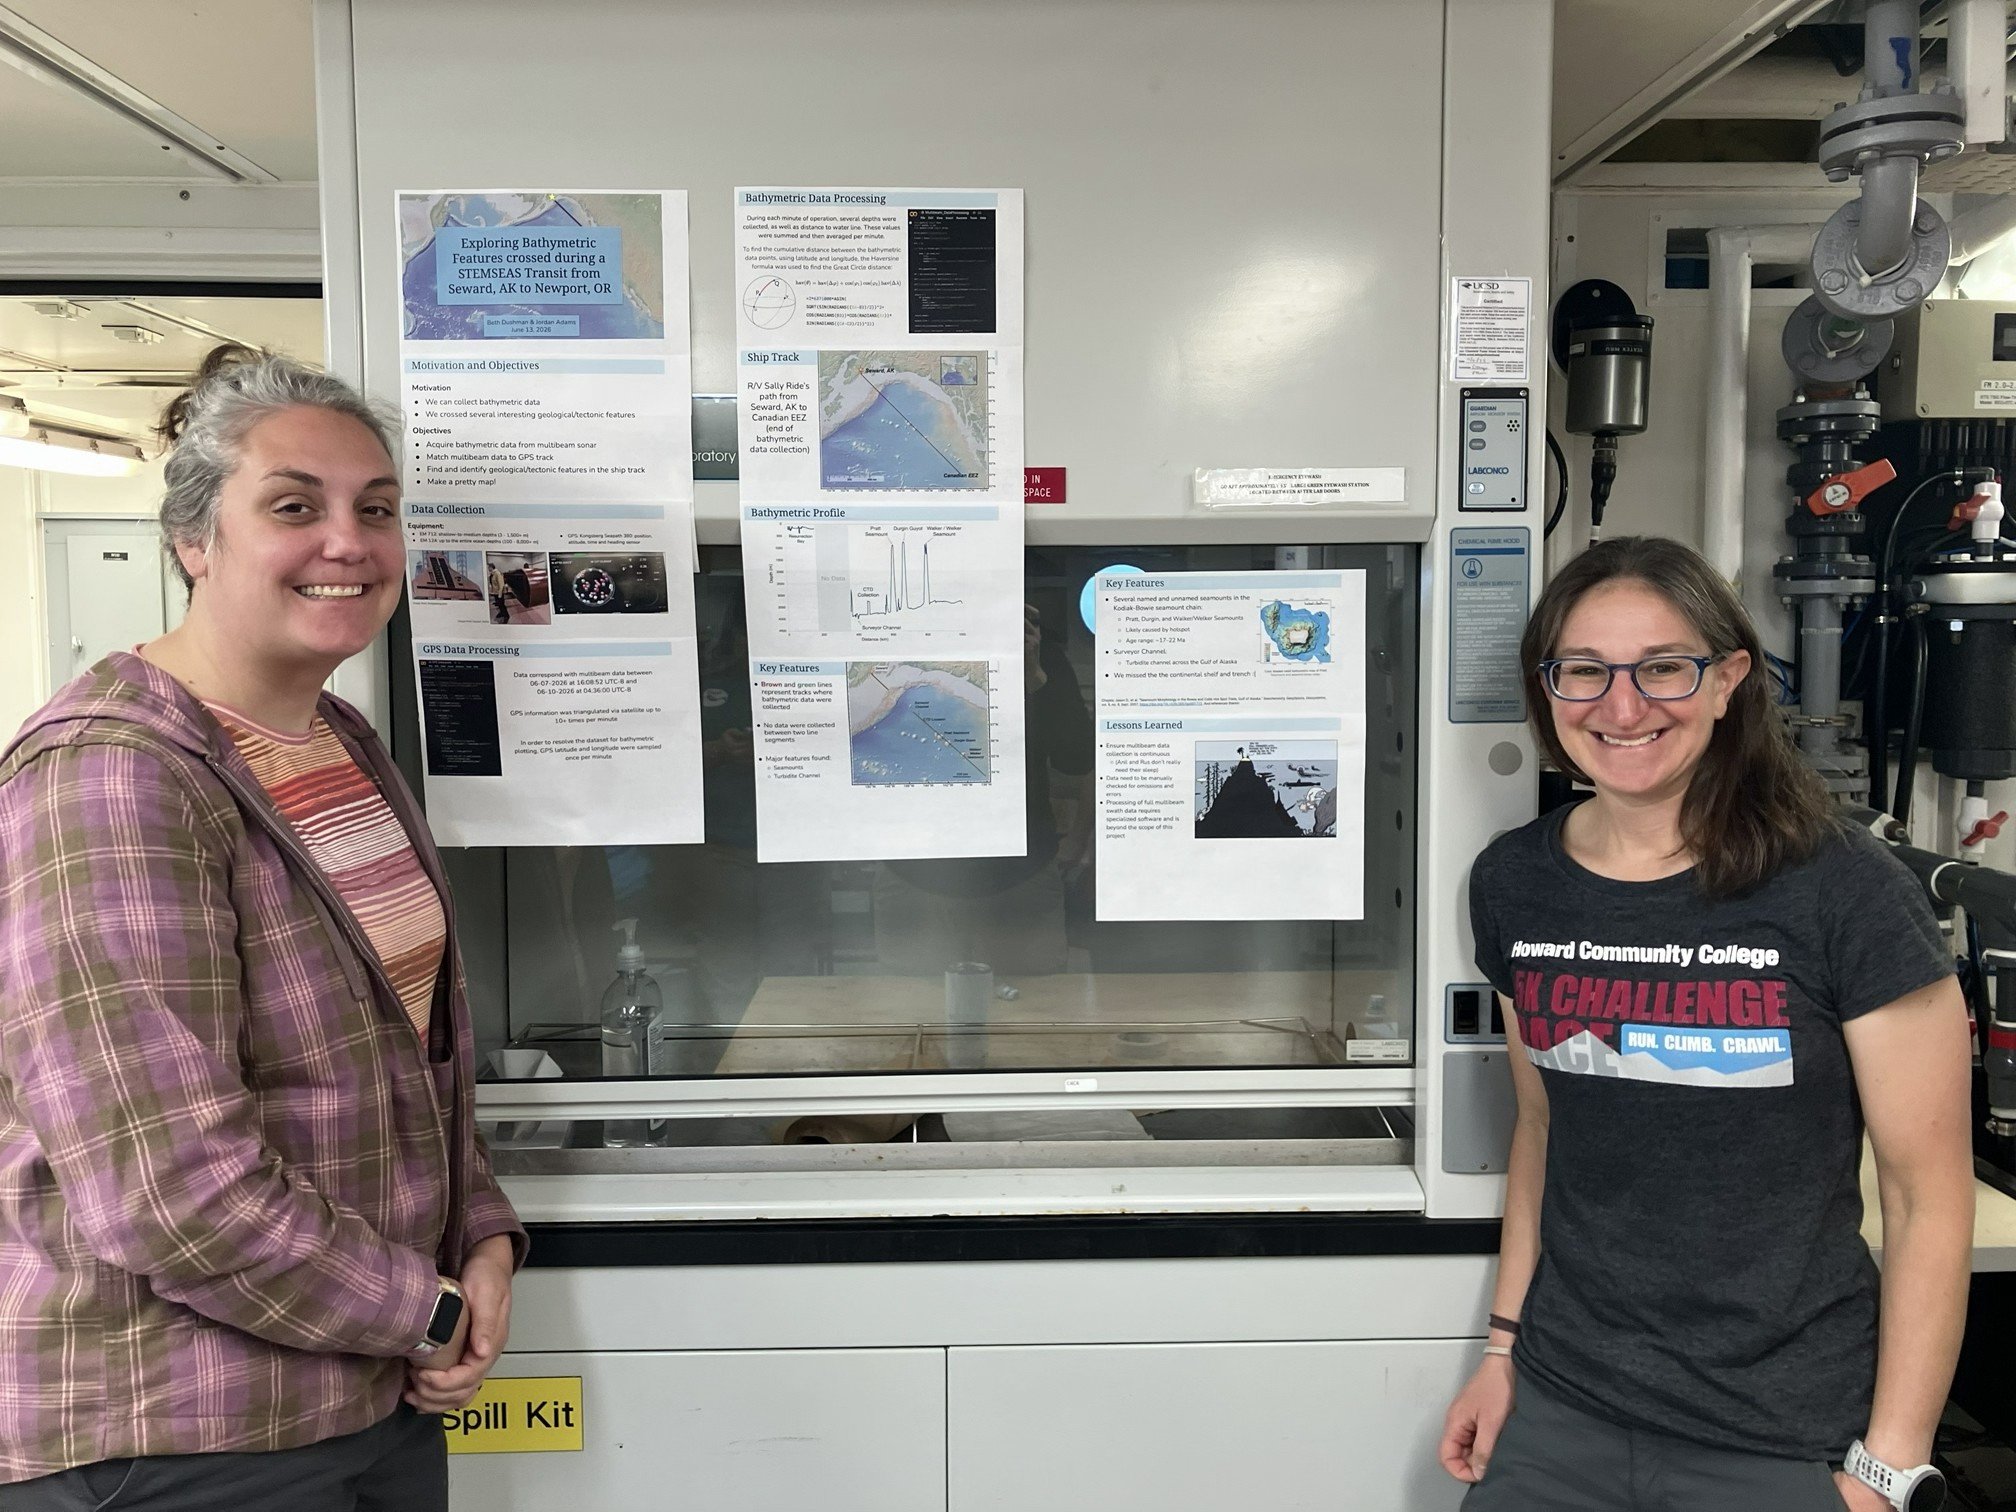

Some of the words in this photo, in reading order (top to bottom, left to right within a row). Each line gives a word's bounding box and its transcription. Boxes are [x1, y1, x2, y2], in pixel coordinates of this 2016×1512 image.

[745, 193, 806, 205] Bathymetric
[808, 194, 831, 203] Data
[833, 193, 886, 206] Processing
[746, 214, 766, 222] During
[860, 215, 881, 223] depths
[461, 237, 519, 251] Exploring
[522, 237, 596, 251] Bathymetric
[452, 253, 503, 264] Features
[506, 252, 551, 263] crossed
[554, 252, 595, 266] during
[598, 254, 605, 263] a
[458, 267, 521, 279] STEMSEAS
[523, 267, 567, 279] Transit
[571, 267, 600, 279] from
[448, 283, 496, 295] Seward,
[499, 283, 517, 293] AK
[519, 284, 531, 293] to
[534, 282, 590, 296] Newport,
[593, 282, 612, 294] OR
[1473, 282, 1499, 290] UCSD
[747, 352, 769, 364] Ship
[770, 352, 799, 362] Track
[411, 360, 464, 370] Motivation
[467, 360, 486, 370] and
[488, 360, 539, 372] Objectives
[411, 384, 451, 392] Motivation
[747, 381, 762, 390] R/V
[764, 381, 784, 391] Sally
[785, 381, 810, 390] Ride's
[759, 392, 777, 401] path
[779, 392, 798, 401] from
[425, 398, 438, 406] We
[453, 398, 478, 406] collect
[479, 398, 522, 407] bathymetric
[523, 398, 540, 406] data
[750, 402, 783, 412] Seward,
[784, 402, 797, 411] AK
[798, 403, 807, 411] to
[425, 410, 438, 418] We
[439, 410, 468, 418] crossed
[469, 410, 496, 418] several
[497, 411, 536, 420] interesting
[537, 411, 604, 420] geological/tectonic
[605, 411, 635, 419] features
[751, 413, 789, 422] Canadian
[790, 413, 806, 422] EEZ
[412, 426, 451, 436] Objectives
[766, 424, 783, 433] (end
[785, 424, 794, 433] of
[425, 440, 454, 449] Acquire
[455, 441, 499, 449] bathymetric
[500, 441, 517, 449] data
[518, 440, 535, 449] from
[537, 441, 575, 449] multibeam
[756, 435, 803, 444] bathymetric
[749, 445, 767, 454] data
[769, 445, 810, 454] collection)
[426, 453, 449, 461] Match
[450, 453, 489, 461] multibeam
[490, 453, 507, 461] data
[517, 453, 534, 461] GPS
[426, 465, 443, 473] Find
[444, 465, 458, 473] and
[459, 465, 487, 474] identify
[488, 466, 556, 475] geological/tectonic
[557, 466, 587, 474] features
[597, 466, 609, 474] the
[610, 466, 626, 475] ship
[627, 466, 645, 474] track
[1468, 467, 1509, 475] LABCONCO
[427, 477, 447, 485] Make
[454, 478, 476, 486] pretty
[478, 478, 496, 487] map!
[1032, 475, 1041, 484] IN
[1024, 488, 1051, 497] SPACE
[411, 504, 434, 514] Data
[436, 504, 485, 514] Collection
[751, 508, 811, 520] Bathymetric
[813, 508, 845, 517] Profile
[407, 522, 444, 530] Equipment:
[1105, 579, 1123, 590] Key
[1125, 579, 1164, 588] Features
[1113, 595, 1135, 603] Several
[422, 644, 441, 654] GPS
[443, 645, 466, 654] Data
[468, 645, 519, 657] Processing
[759, 663, 777, 675] Key
[779, 664, 819, 673] Features
[761, 689, 791, 697] represent
[761, 696, 798, 704] bathymetric
[1106, 721, 1142, 730] Lessons
[1144, 720, 1182, 729] Learned
[1511, 940, 1575, 959] Howard
[1579, 941, 1694, 967] Community
[1698, 944, 1779, 969] College
[1551, 973, 1790, 1027] CHALLENGE
[1628, 1032, 1658, 1049] RUN.
[1664, 1034, 1716, 1053] CLIMB.
[1723, 1037, 1786, 1054] CRAWL.
[443, 1403, 507, 1435] Spill
[527, 1401, 575, 1428] Kit
